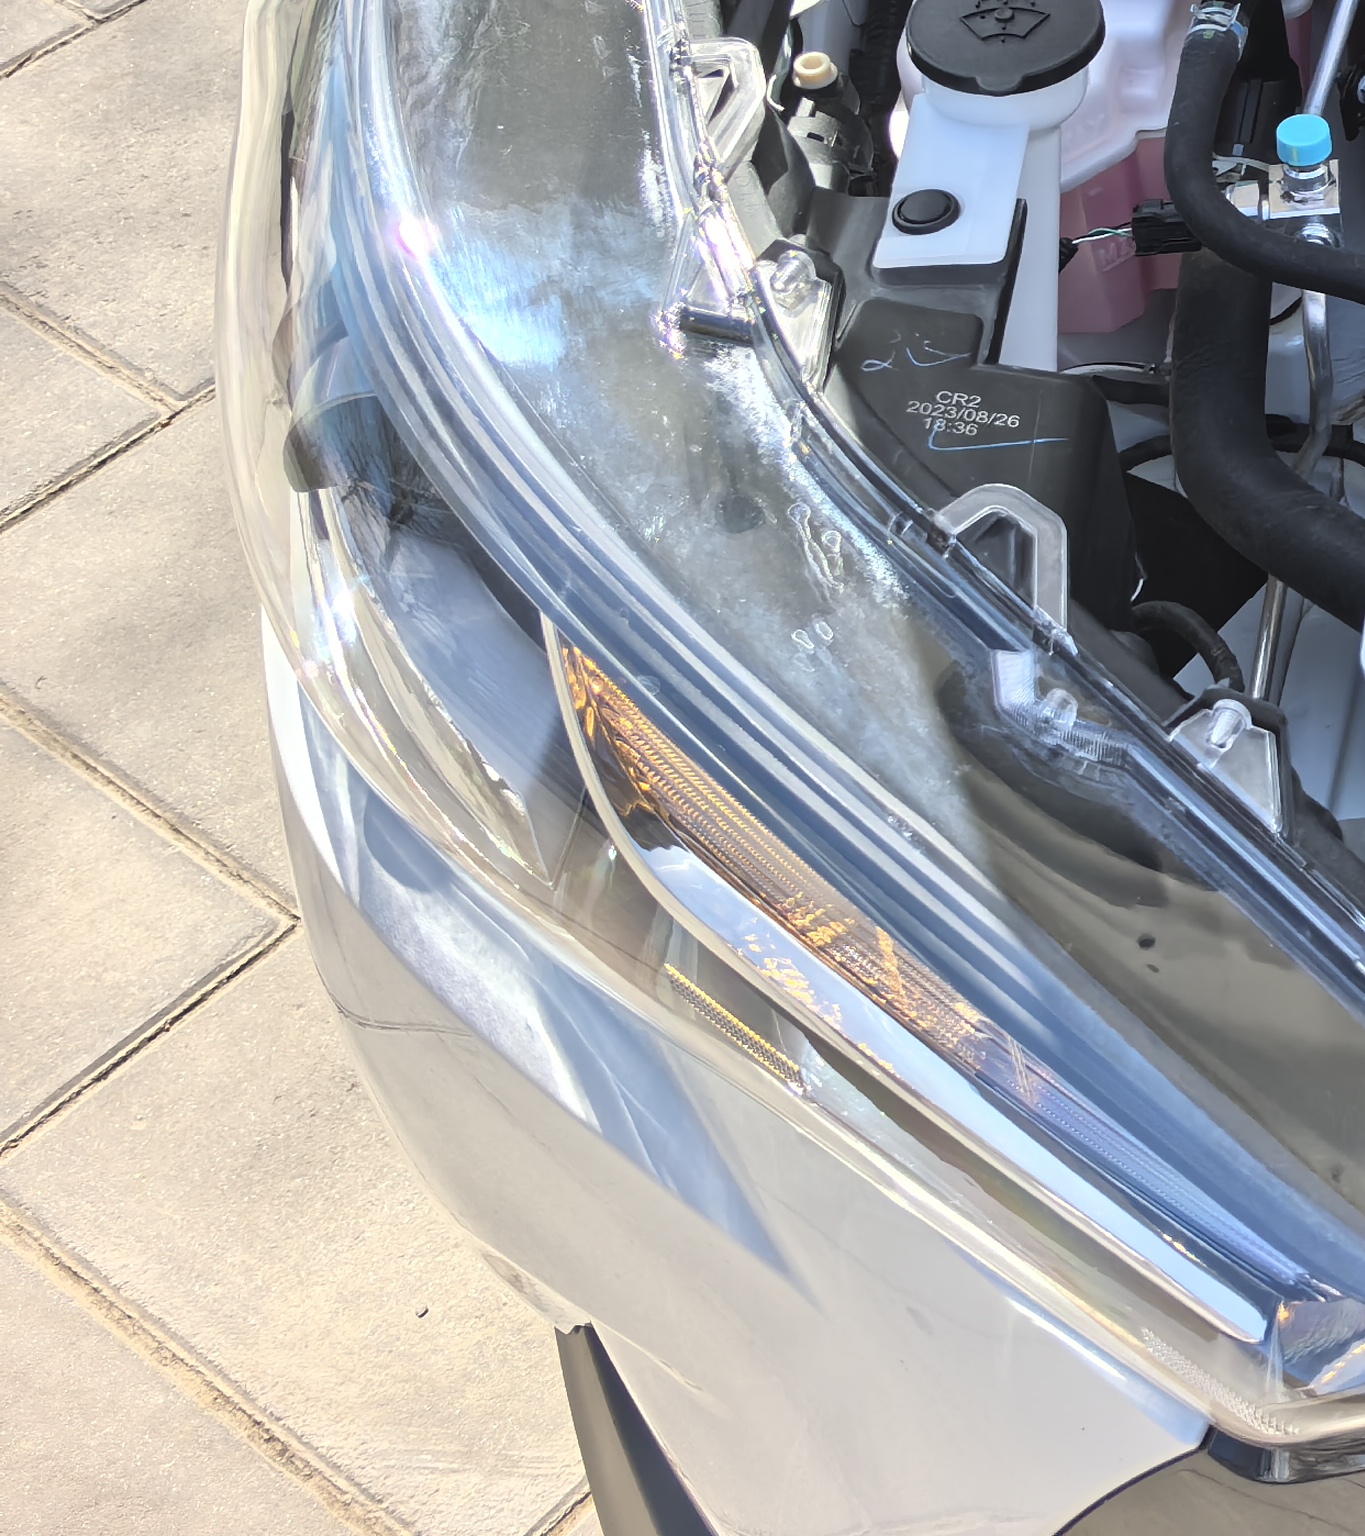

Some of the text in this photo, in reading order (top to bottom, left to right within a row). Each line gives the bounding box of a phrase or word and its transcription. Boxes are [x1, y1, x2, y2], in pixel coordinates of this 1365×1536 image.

[936, 391, 982, 408] CR2
[906, 400, 1020, 428] 2023/08/26
[924, 417, 978, 436] 18:36
